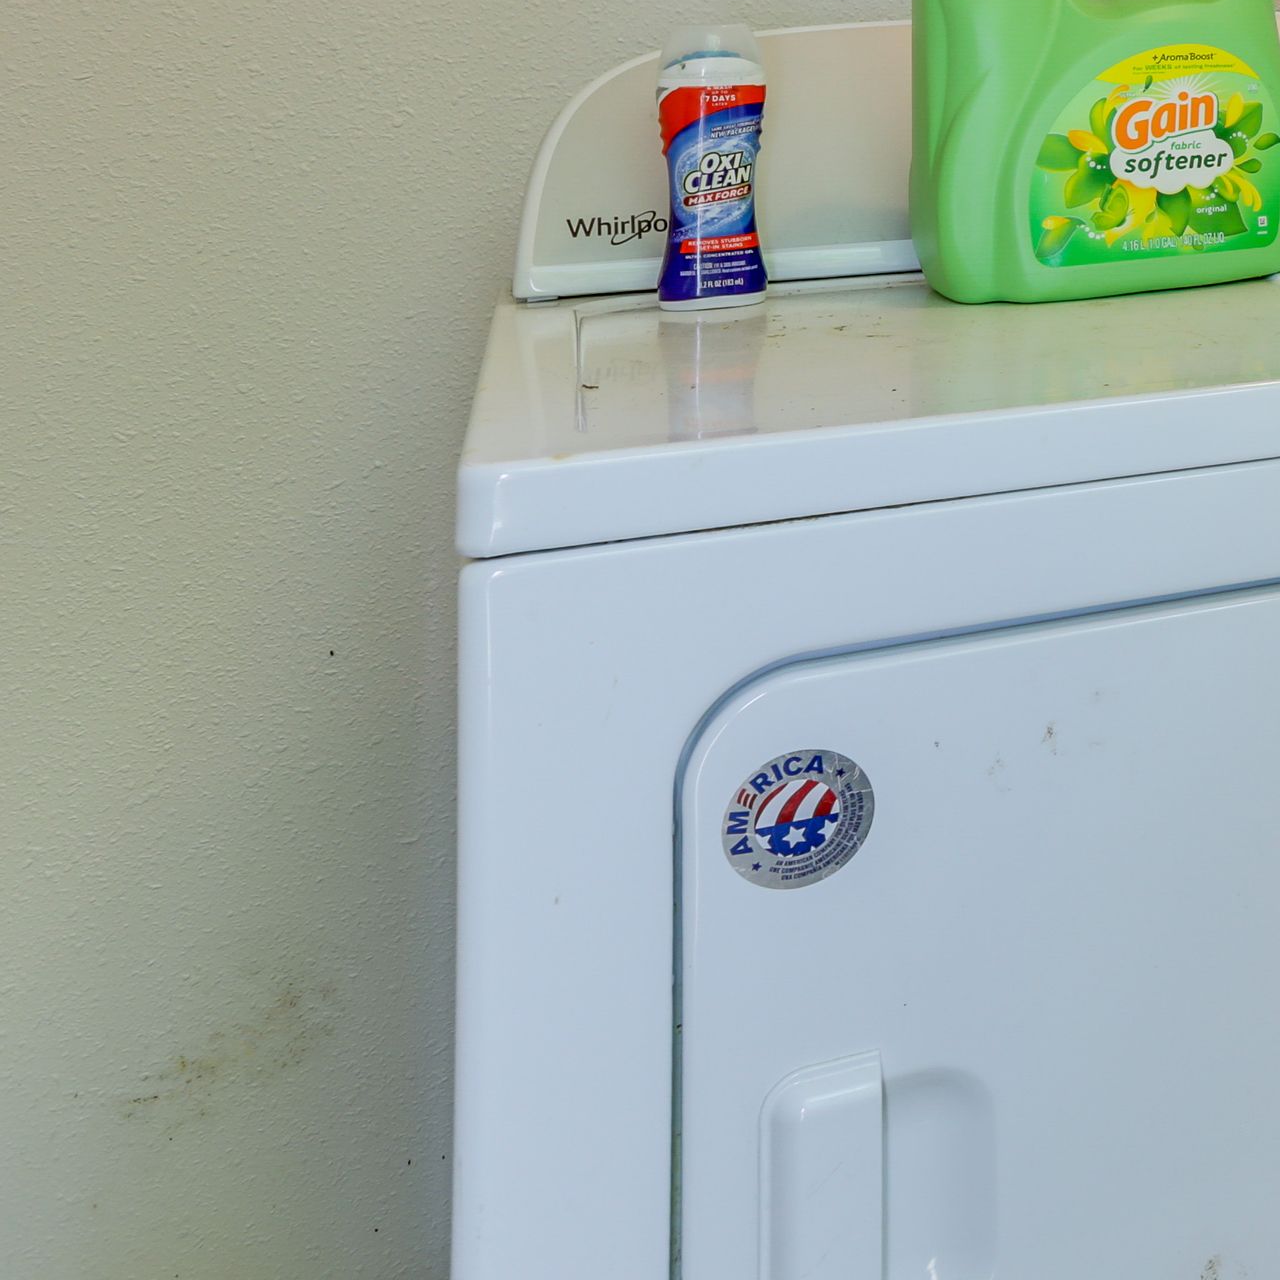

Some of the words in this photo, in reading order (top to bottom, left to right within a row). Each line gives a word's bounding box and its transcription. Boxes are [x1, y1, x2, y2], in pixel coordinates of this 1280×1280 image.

[712, 94, 736, 102] DAYS
[1115, 91, 1215, 150] Gain
[710, 129, 725, 138] NEW
[1170, 140, 1202, 151] fabric
[700, 152, 743, 174] OXI
[1124, 150, 1228, 179] softener
[684, 164, 752, 194] CLEAN
[688, 193, 713, 206] MAX
[715, 185, 750, 200] FORCE
[1196, 203, 1228, 216] original
[566, 213, 668, 241] Whirlpo
[1122, 239, 1139, 251] 4.16
[708, 280, 714, 288] FL
[714, 279, 722, 287] OZ
[726, 755, 824, 856] AMERICA
